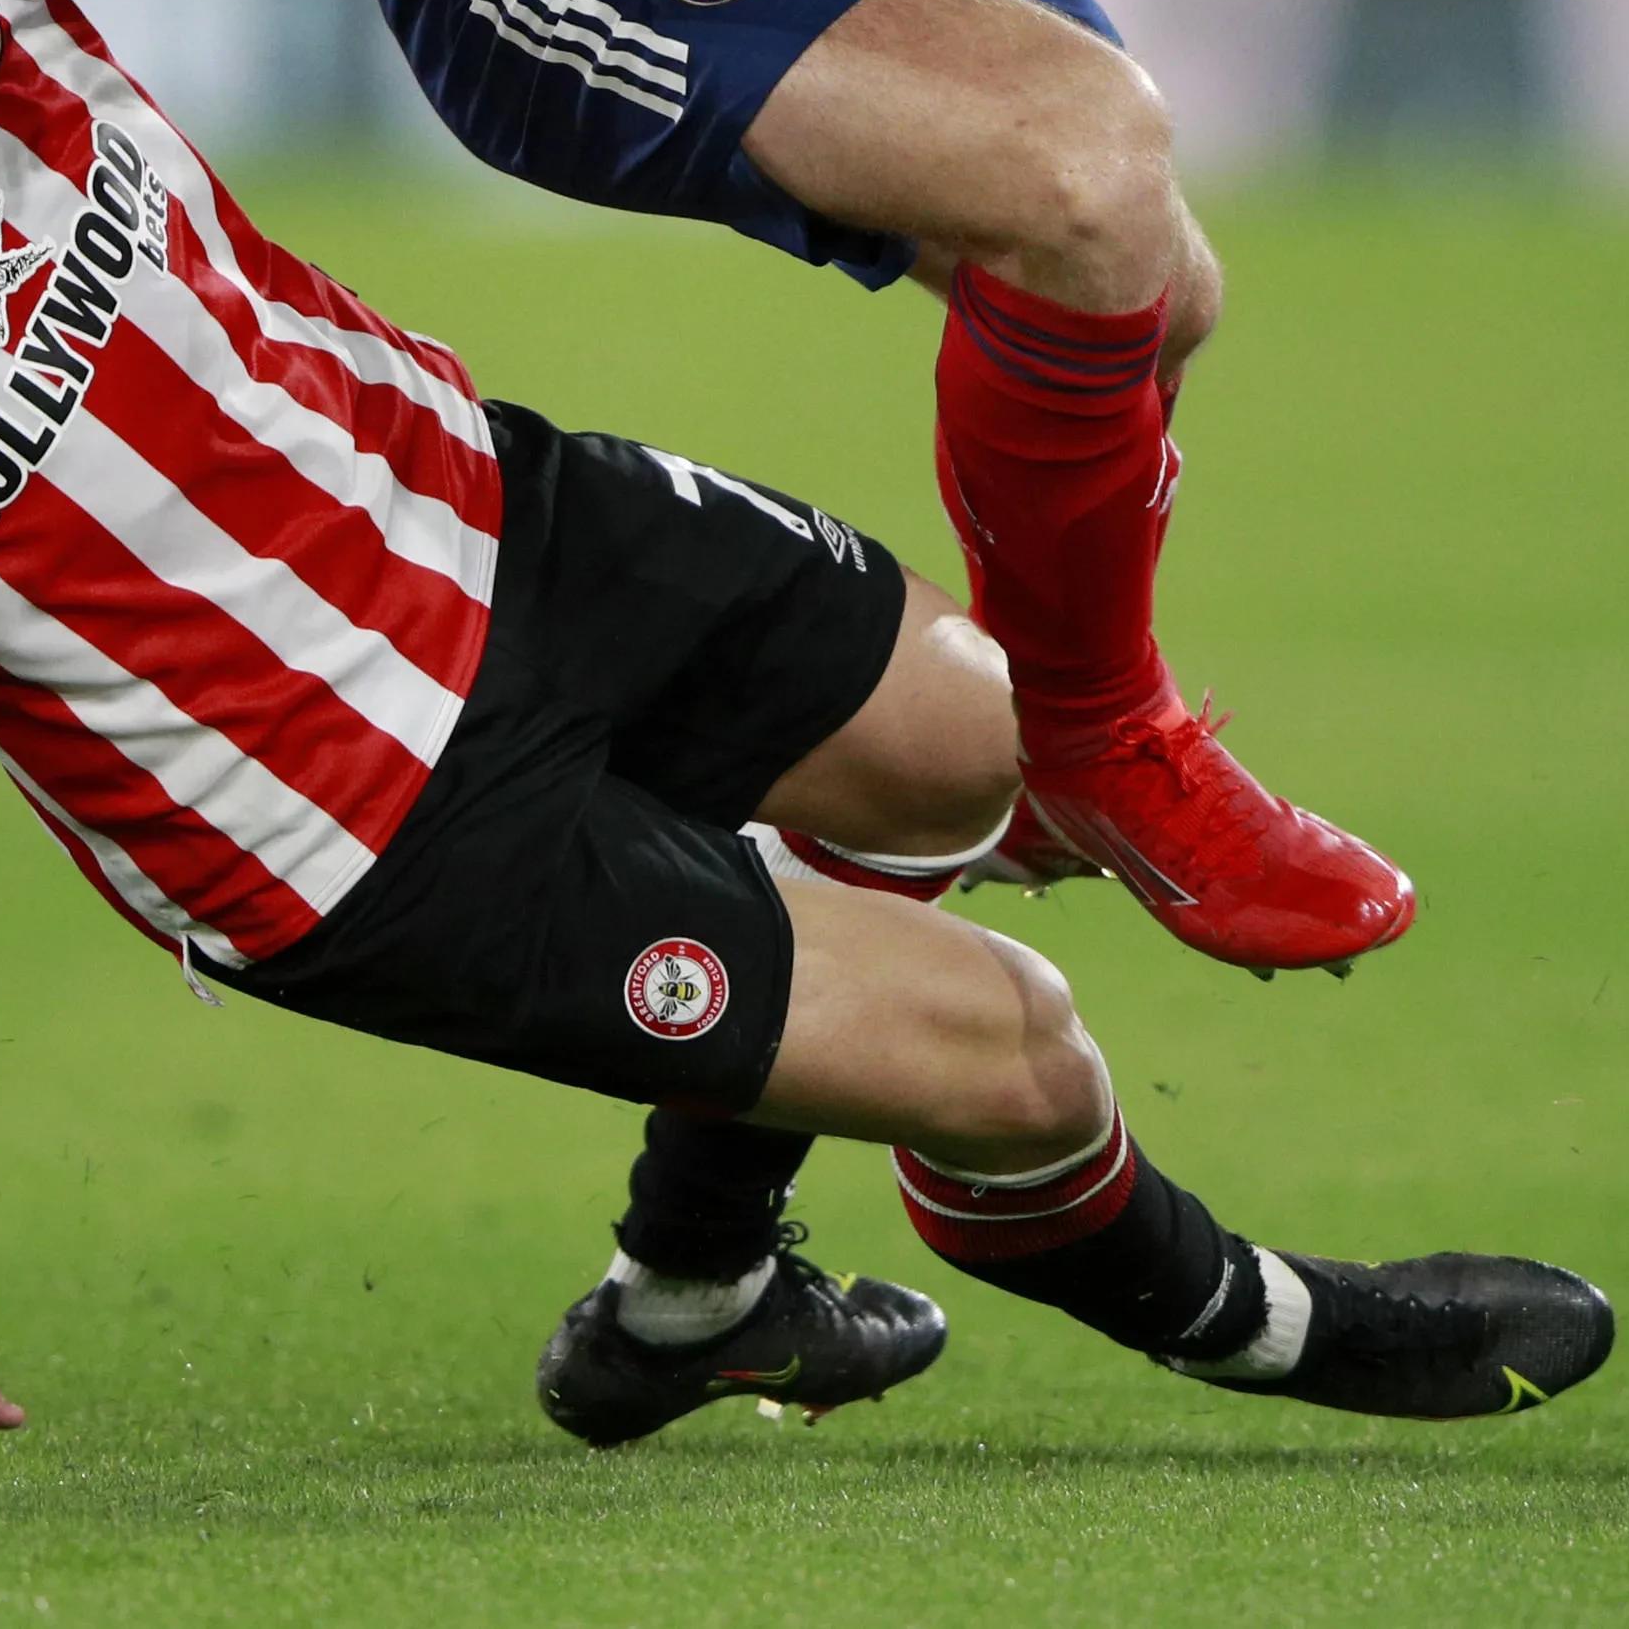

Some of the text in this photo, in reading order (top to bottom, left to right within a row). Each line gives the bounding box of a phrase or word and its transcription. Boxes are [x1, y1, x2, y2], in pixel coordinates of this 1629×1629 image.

[138, 172, 166, 272] bets
[631, 951, 660, 1022] BRENTFORD
[696, 957, 724, 1029] FOOTBALL CLUB
